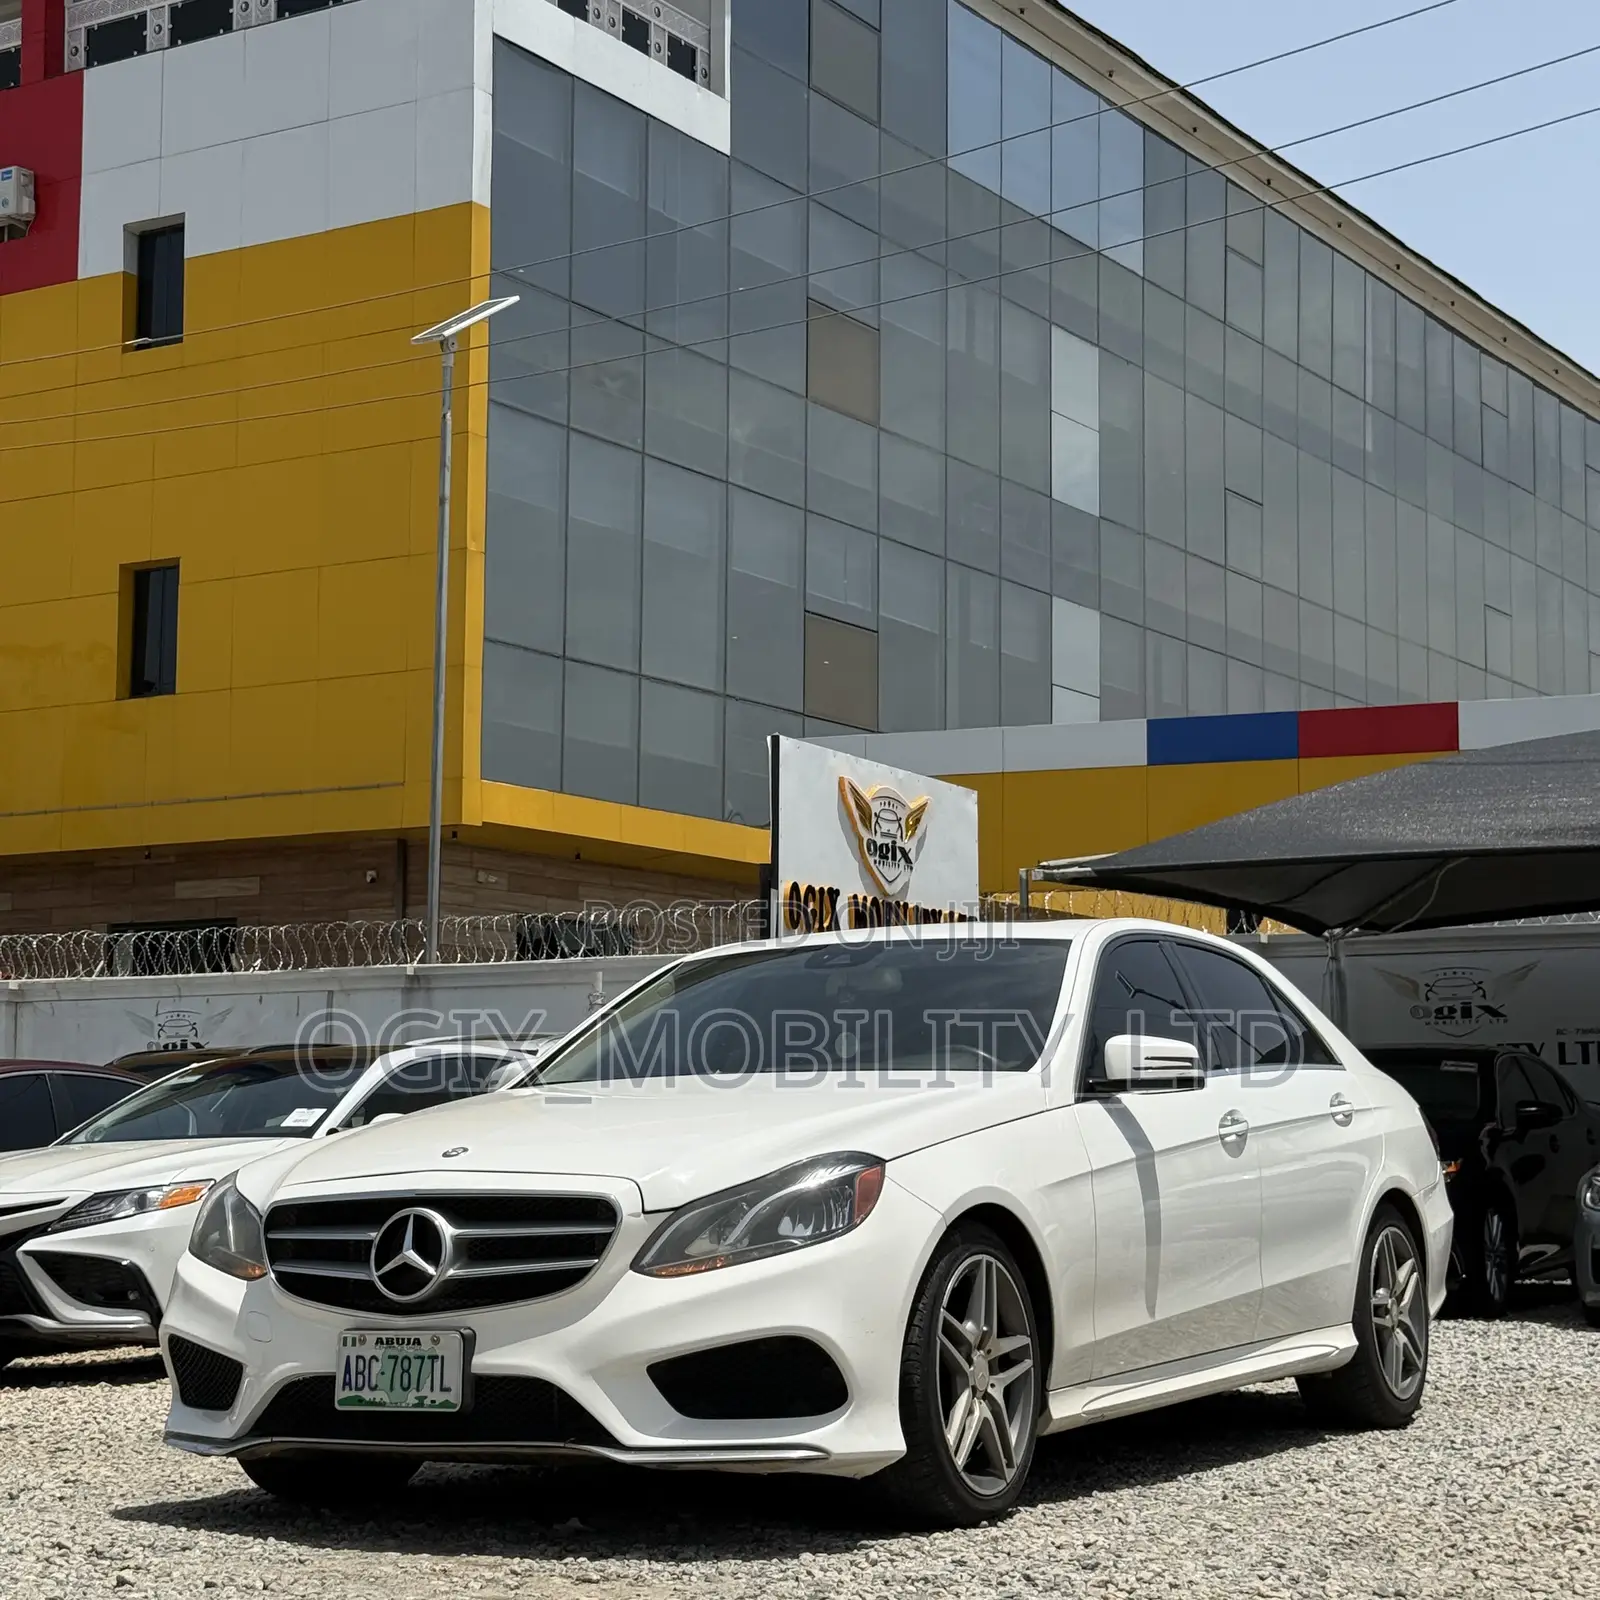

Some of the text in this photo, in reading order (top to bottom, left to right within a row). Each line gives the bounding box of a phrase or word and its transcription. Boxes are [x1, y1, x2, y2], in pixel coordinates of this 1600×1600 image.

[785, 881, 841, 934] OGIX
[1557, 1040, 1600, 1066] LT
[375, 1337, 422, 1346] ABUJA
